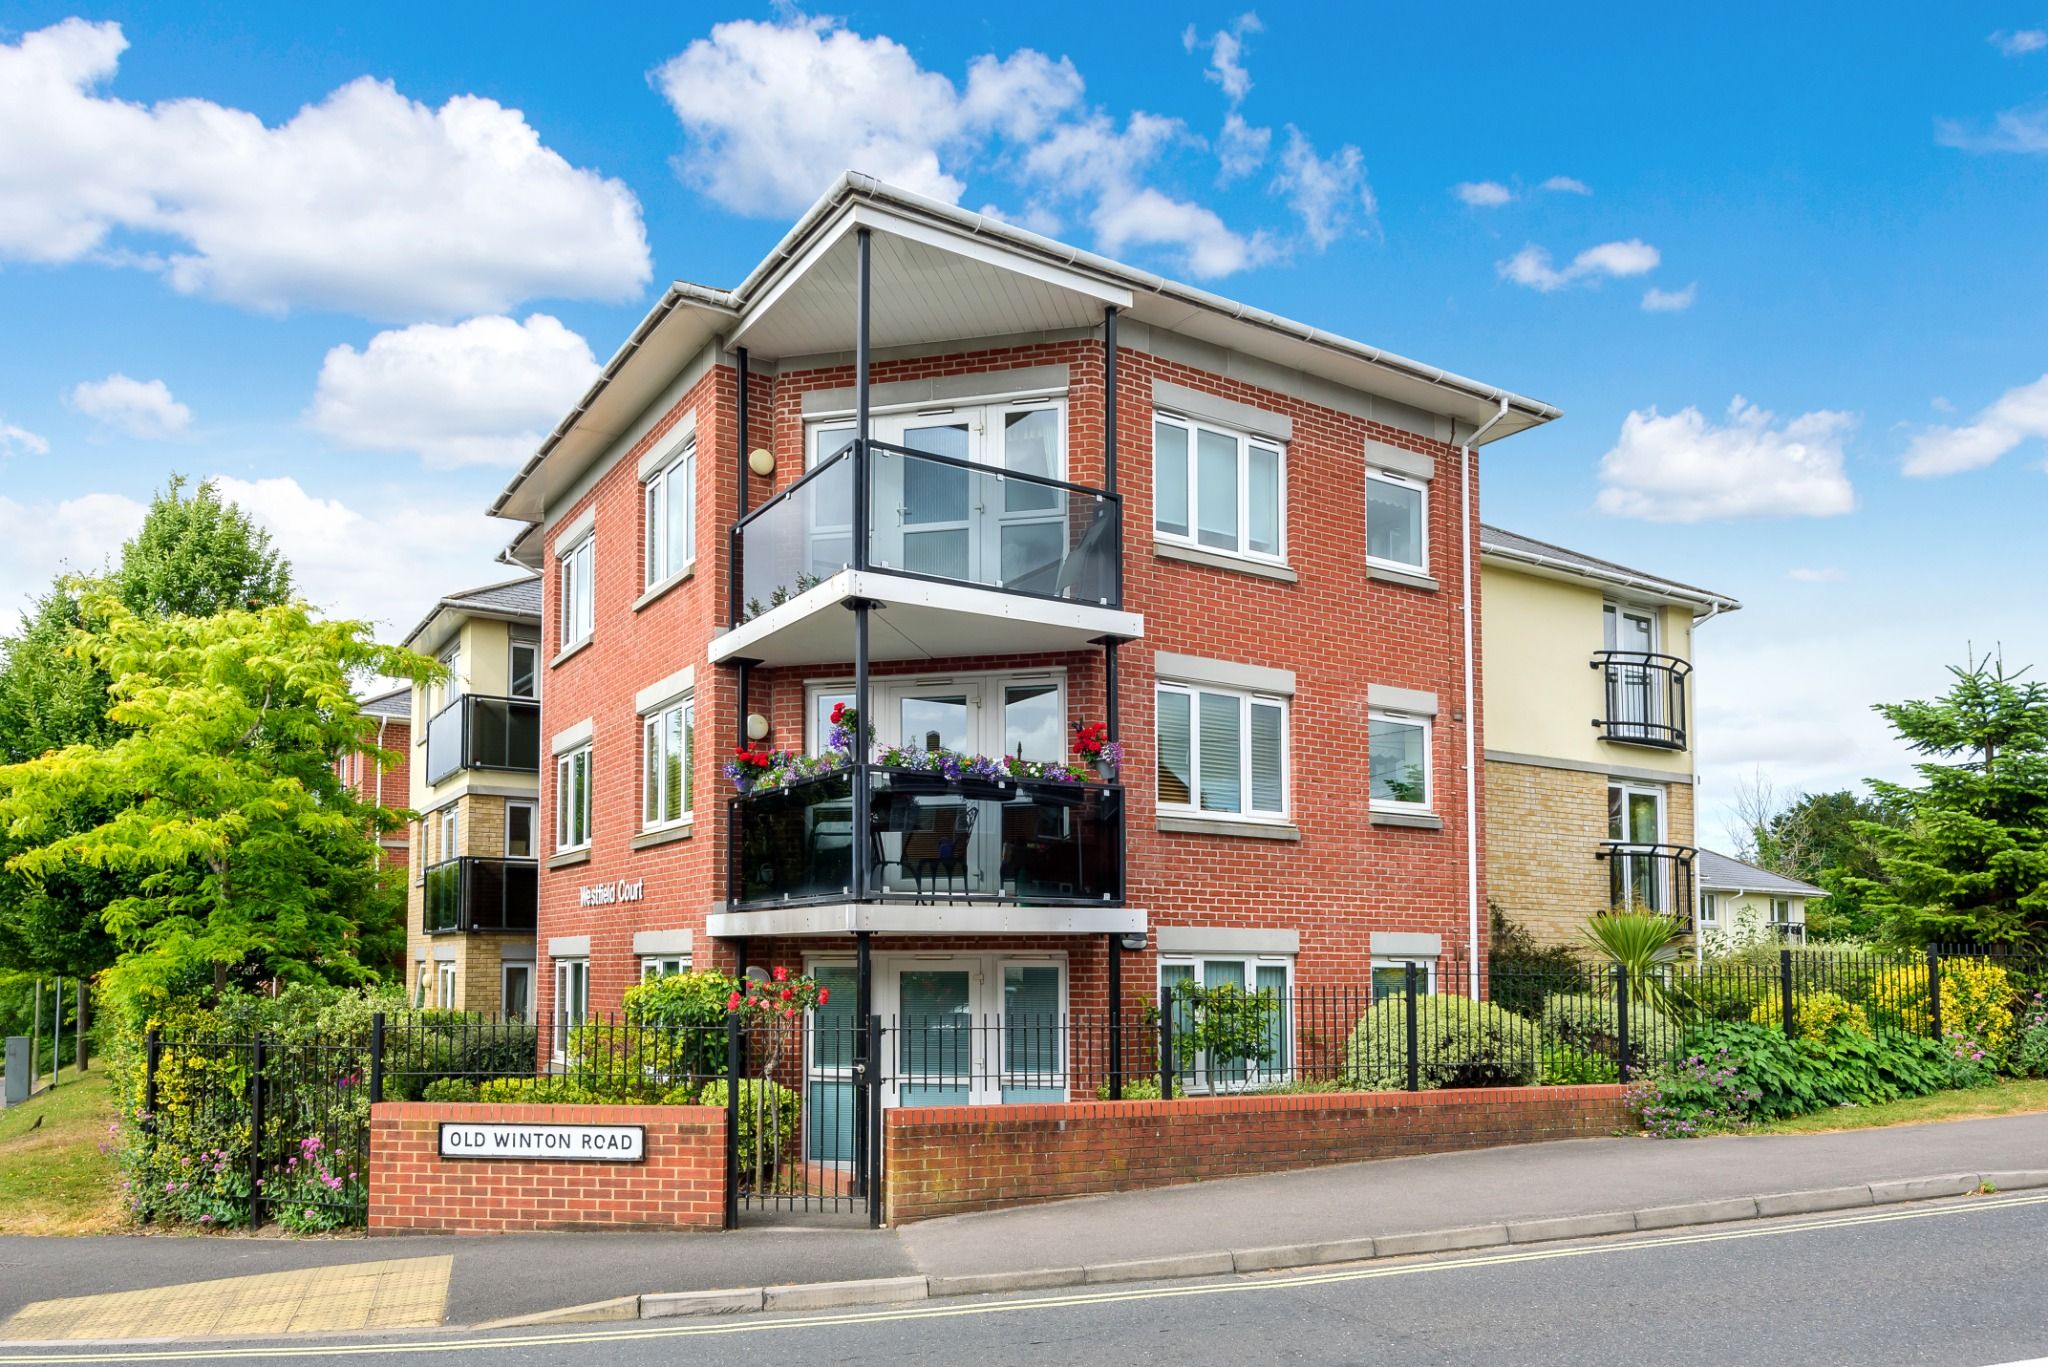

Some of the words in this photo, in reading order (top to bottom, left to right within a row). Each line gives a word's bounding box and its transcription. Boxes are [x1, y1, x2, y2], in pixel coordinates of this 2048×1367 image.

[580, 881, 616, 907] Westfield
[618, 877, 643, 902] Court
[450, 1131, 486, 1148] OLD
[494, 1132, 571, 1149] WINTON
[582, 1134, 633, 1150] ROAD
